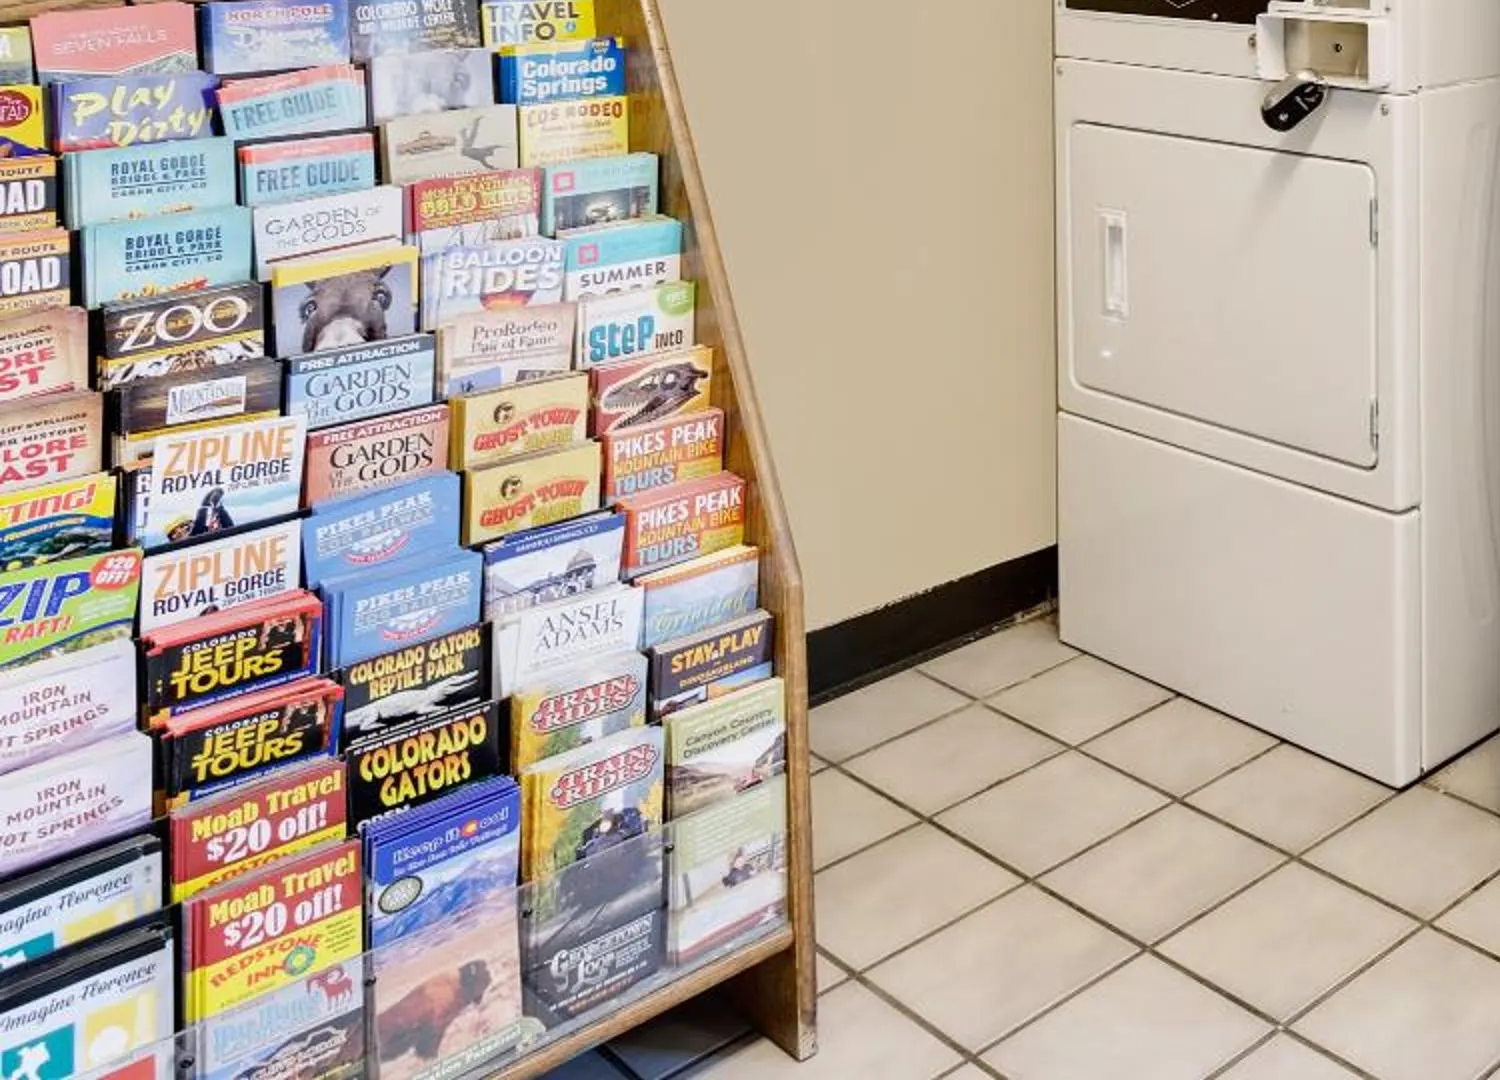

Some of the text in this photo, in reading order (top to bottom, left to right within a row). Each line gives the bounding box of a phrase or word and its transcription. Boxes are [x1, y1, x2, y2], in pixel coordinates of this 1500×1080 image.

[355, 0, 418, 21] COLORADO
[487, 1, 580, 22] TRAVEL
[54, 35, 111, 56] SEVEN
[116, 28, 168, 48] FALLS
[490, 23, 557, 43] INFO
[522, 55, 618, 80] Colorado
[69, 79, 176, 128] Play
[521, 75, 609, 100] Springs
[231, 86, 337, 132] FREE GUIDE
[565, 101, 623, 119] RODEO
[111, 152, 207, 178] ROYAL GORGE
[256, 158, 362, 193] FREE GUIDE
[265, 206, 360, 236] GARDEN
[301, 220, 367, 244] GODS
[125, 226, 223, 252] ROYAL GORGE
[125, 248, 173, 261] BRIDGE
[450, 246, 562, 270] BALLOON
[580, 261, 667, 288] SUMMER
[447, 264, 562, 298] RIDES
[118, 295, 252, 353] ZOO
[300, 340, 421, 372] FREE ATTRACTION
[305, 362, 413, 400] GARDEN
[334, 380, 412, 413] GODS
[23, 423, 88, 443] HISTORY
[322, 412, 442, 446] FREE ATTRACTION
[613, 417, 718, 461] PIKES PEAK
[163, 424, 297, 476] ZIPLINE
[330, 429, 435, 469] GARDEN
[613, 448, 685, 478] MOUNTAIN
[161, 458, 292, 495] ROYAL GORGE
[359, 452, 433, 483] GODS
[615, 464, 675, 496] TOURS
[316, 509, 376, 540] PIKES
[381, 490, 433, 518] PEAK
[639, 485, 742, 531] PIKES PEAK
[638, 518, 708, 547] MOUNTAIN
[152, 534, 289, 600] ZIPLINE
[637, 534, 698, 567] TOURS
[0, 571, 91, 626] ZIP
[152, 568, 286, 617] ROYAL GORGE
[356, 585, 415, 613] PIKES
[419, 570, 471, 596] PEAK
[4, 615, 74, 645] RAFT!
[541, 598, 618, 631] ANSEL
[182, 628, 257, 653] COLORADO
[535, 615, 624, 654] ADAMS
[172, 637, 258, 679] JEEP
[351, 628, 481, 686] COLORADO GATORS
[170, 650, 284, 700] TOURS
[368, 654, 465, 702] REPTILE PARK
[22, 684, 67, 707] IRON
[23, 703, 110, 744] SPRINGS
[193, 720, 280, 761] JEEP
[204, 711, 279, 737] COLORADO
[685, 725, 728, 746] Canyon
[191, 731, 305, 782] TOURS
[360, 715, 487, 782] COLORADO
[37, 779, 81, 803] IRON
[380, 752, 471, 807] GATORS
[6, 783, 107, 827] MOUNTAIN
[37, 795, 124, 839] SPRINGS
[191, 796, 259, 842] Moab
[265, 770, 342, 813] Travel
[206, 818, 273, 864] $20
[278, 800, 328, 842] off!
[209, 884, 276, 928] Moab
[281, 850, 356, 898] Travel
[223, 883, 344, 950] $20 off!
[209, 934, 323, 988] REDSTONE
